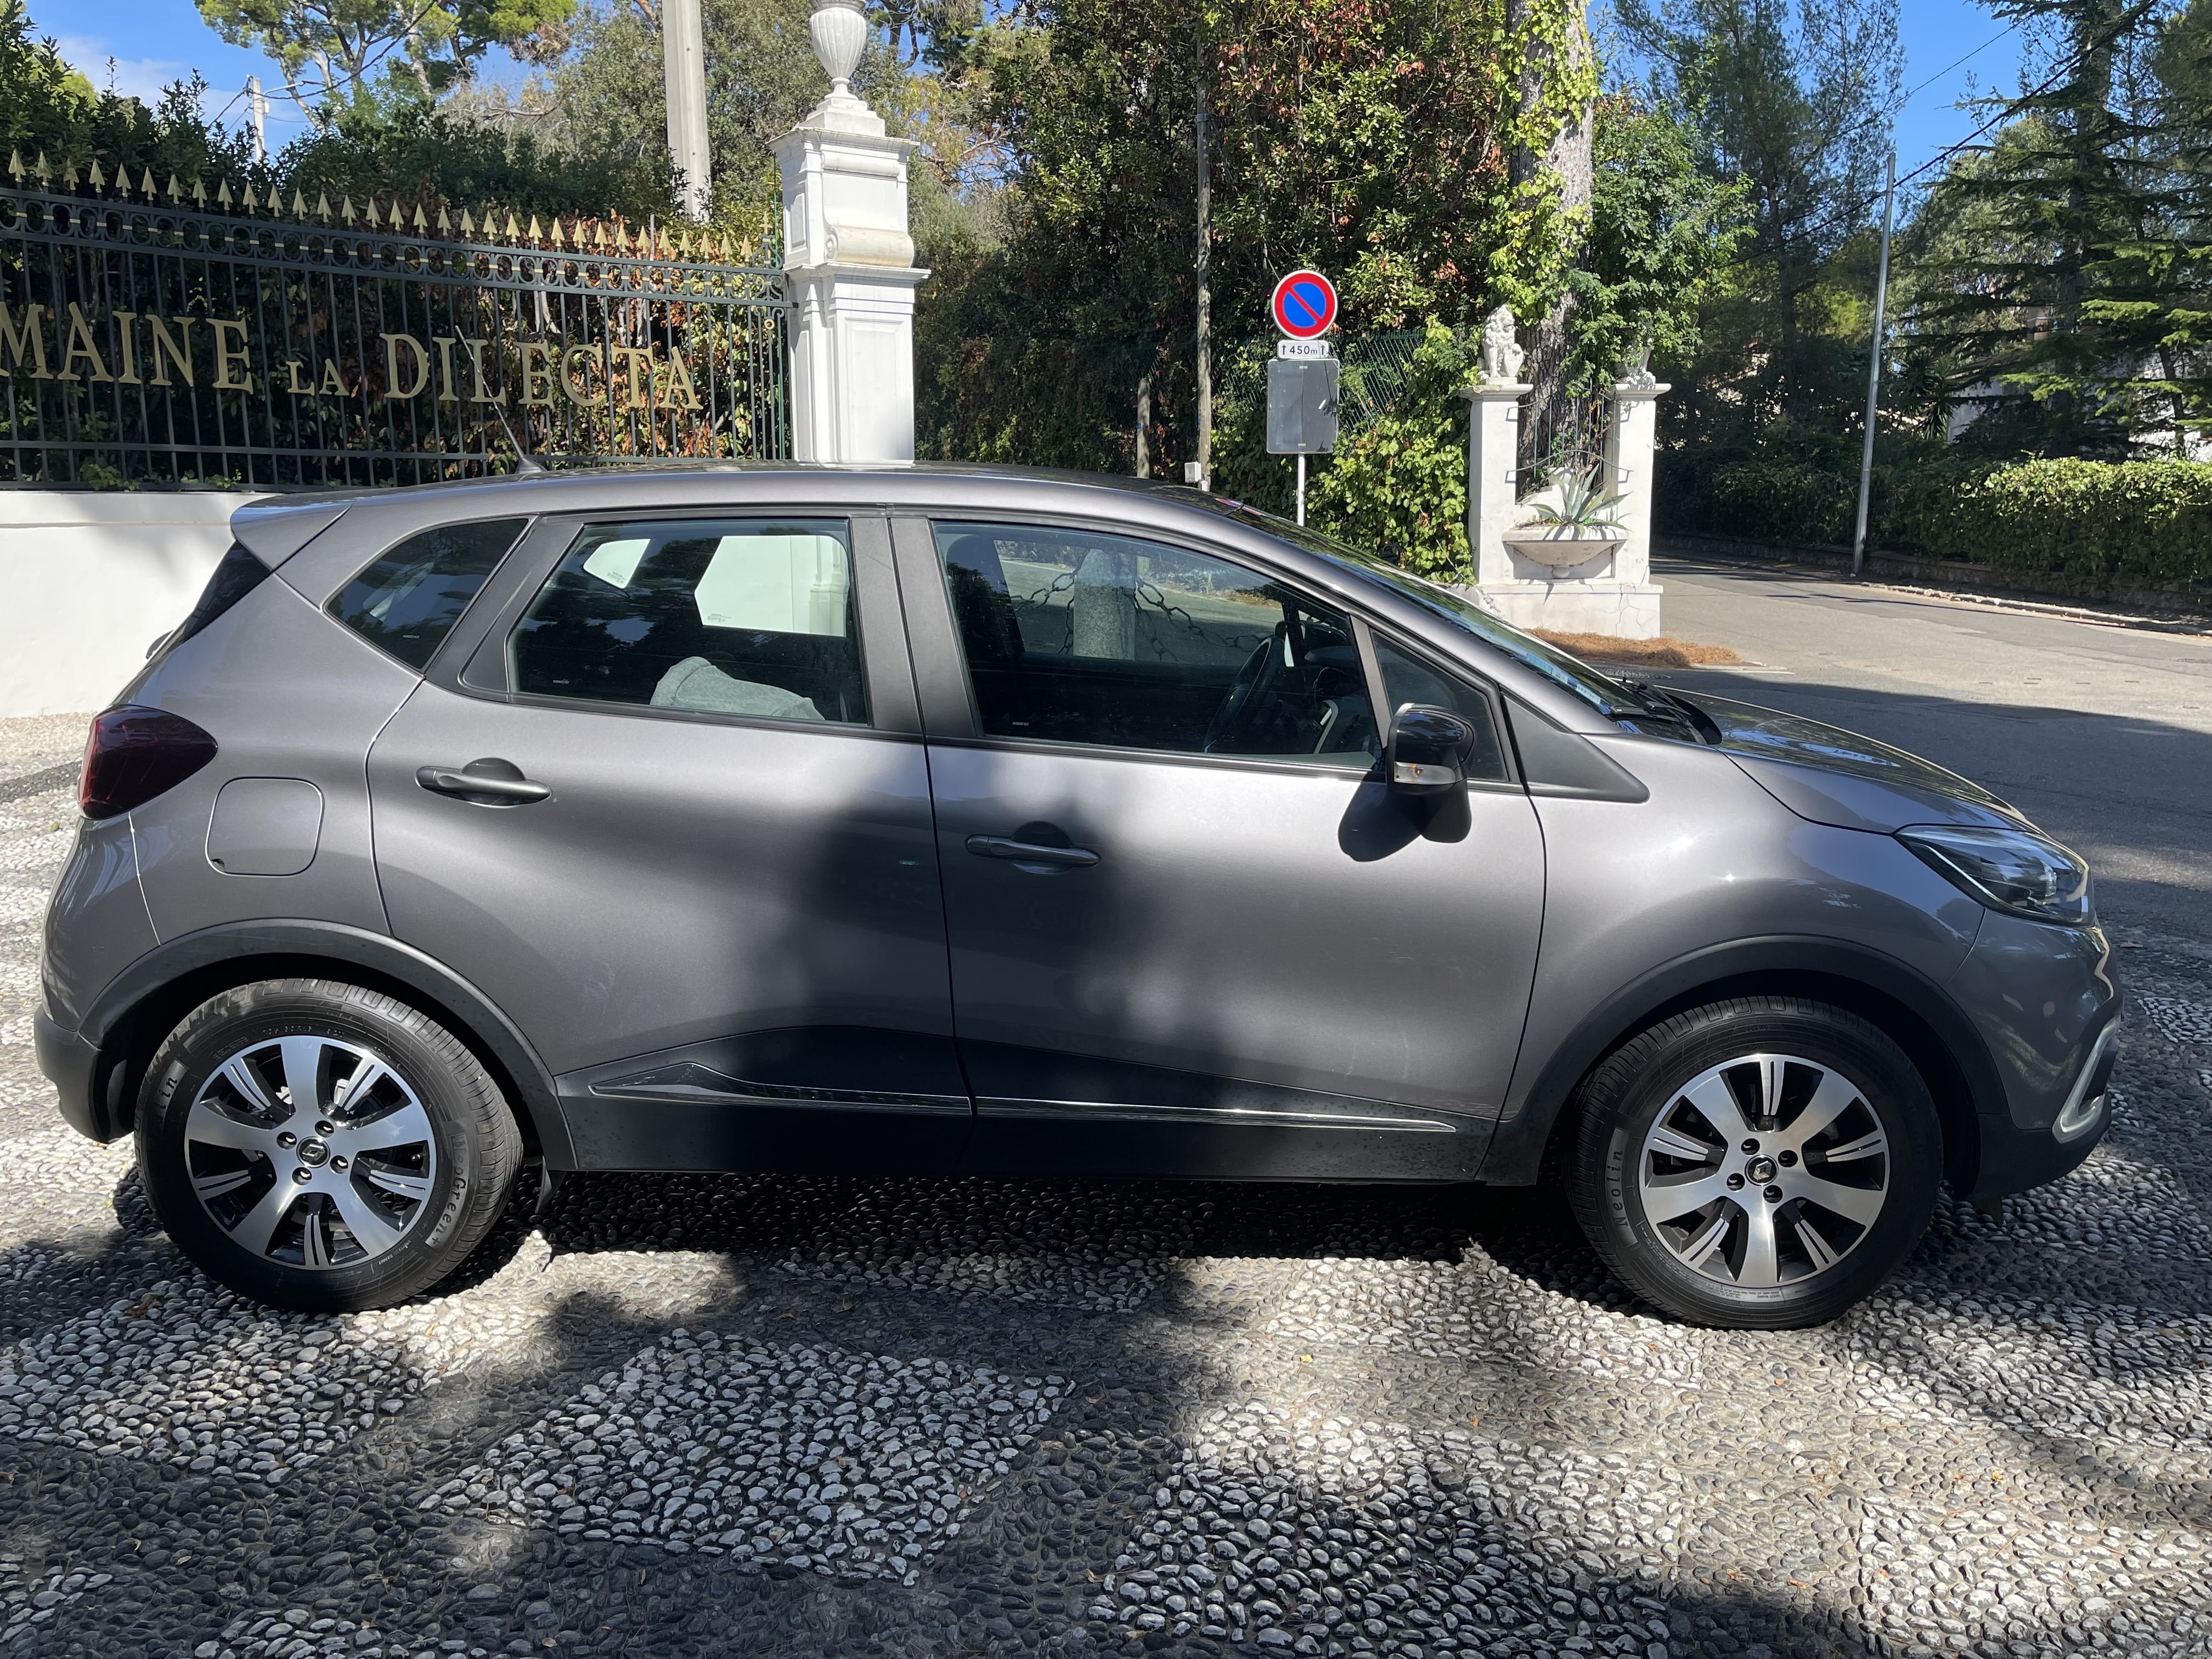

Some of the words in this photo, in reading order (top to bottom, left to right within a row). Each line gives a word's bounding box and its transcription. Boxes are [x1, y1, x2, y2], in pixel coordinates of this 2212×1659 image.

[0, 301, 254, 394] MAINE
[285, 358, 349, 396] LA
[380, 332, 703, 410] DILECTA
[1289, 345, 1318, 355] 450m
